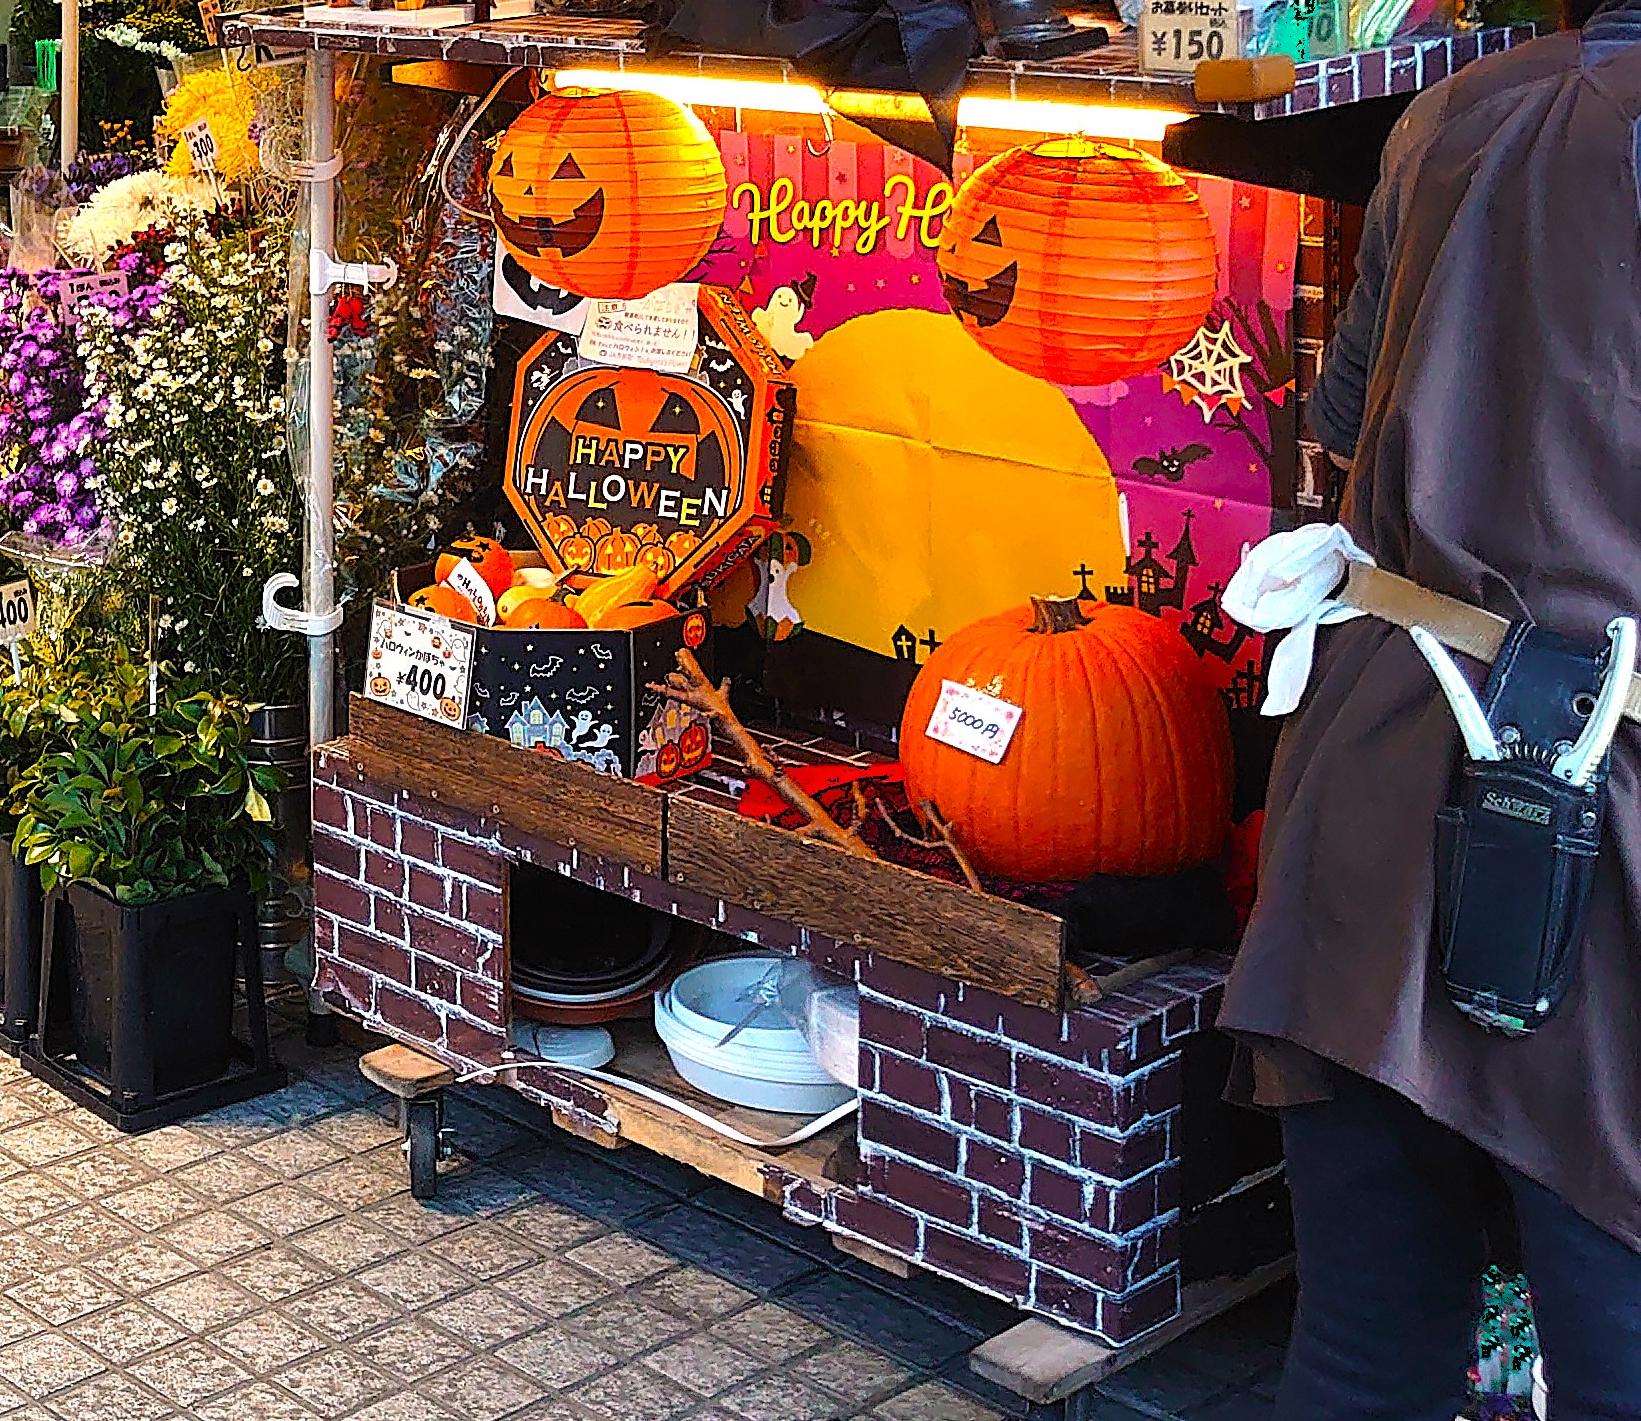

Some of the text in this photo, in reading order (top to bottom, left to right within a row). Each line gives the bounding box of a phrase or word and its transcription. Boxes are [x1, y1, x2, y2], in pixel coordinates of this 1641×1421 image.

[1151, 29, 1224, 61] ¥150
[732, 174, 891, 255] Happy
[576, 437, 686, 474] HAPPY
[525, 467, 728, 527] HALLOWEEN
[380, 638, 446, 668] ハロウィンかぼちゃ
[396, 664, 446, 700] ¥400
[948, 706, 1000, 739] 5000円
